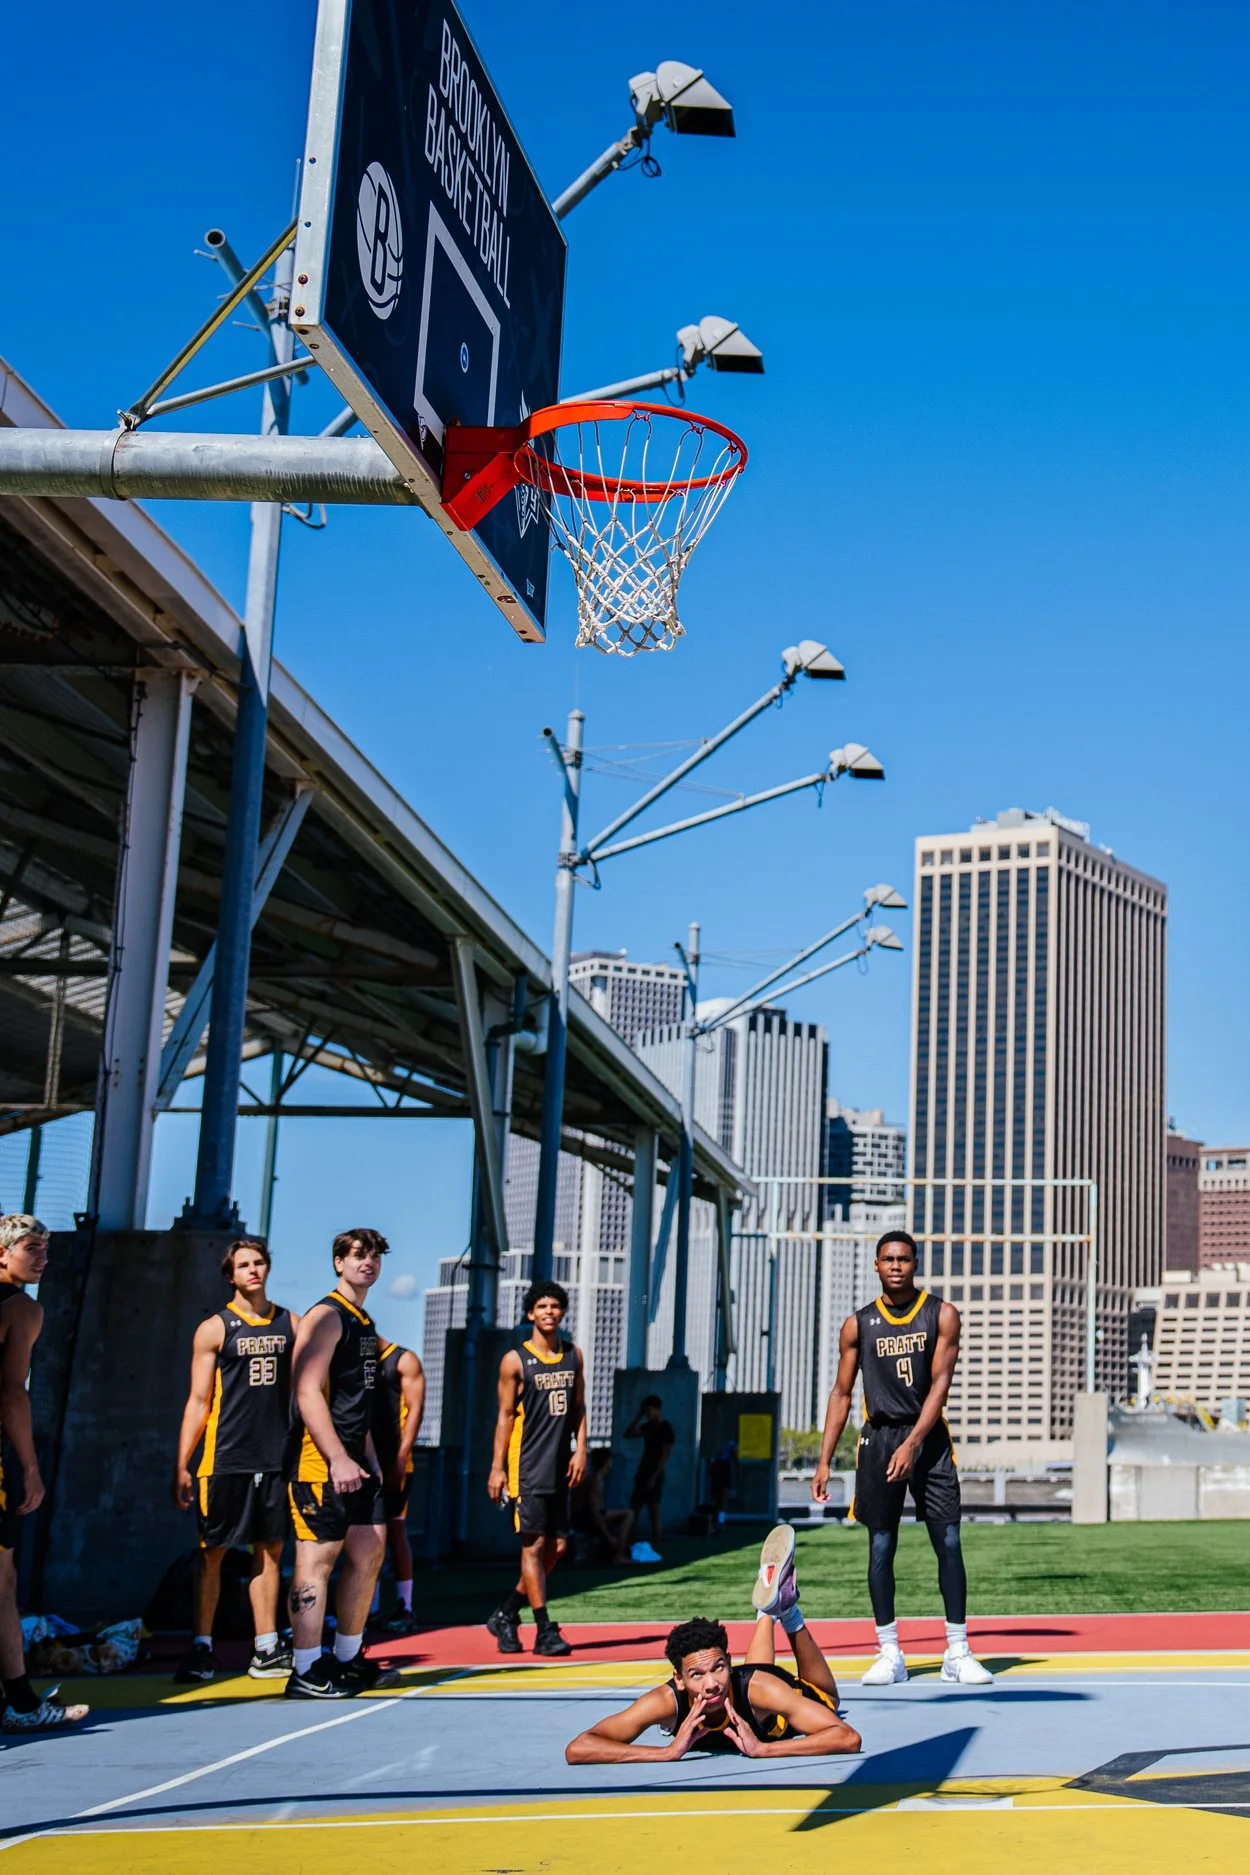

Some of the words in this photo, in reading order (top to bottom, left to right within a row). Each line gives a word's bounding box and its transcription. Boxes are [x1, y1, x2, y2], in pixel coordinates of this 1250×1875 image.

[439, 18, 510, 217] BROOKLYN
[424, 83, 510, 309] BASKETBALL
[236, 1335, 287, 1357] PRATT
[876, 1331, 927, 1357] PRATT
[249, 1357, 278, 1386] 33
[534, 1370, 575, 1391] PRATT
[895, 1357, 914, 1388] 4
[548, 1389, 568, 1416] 15
